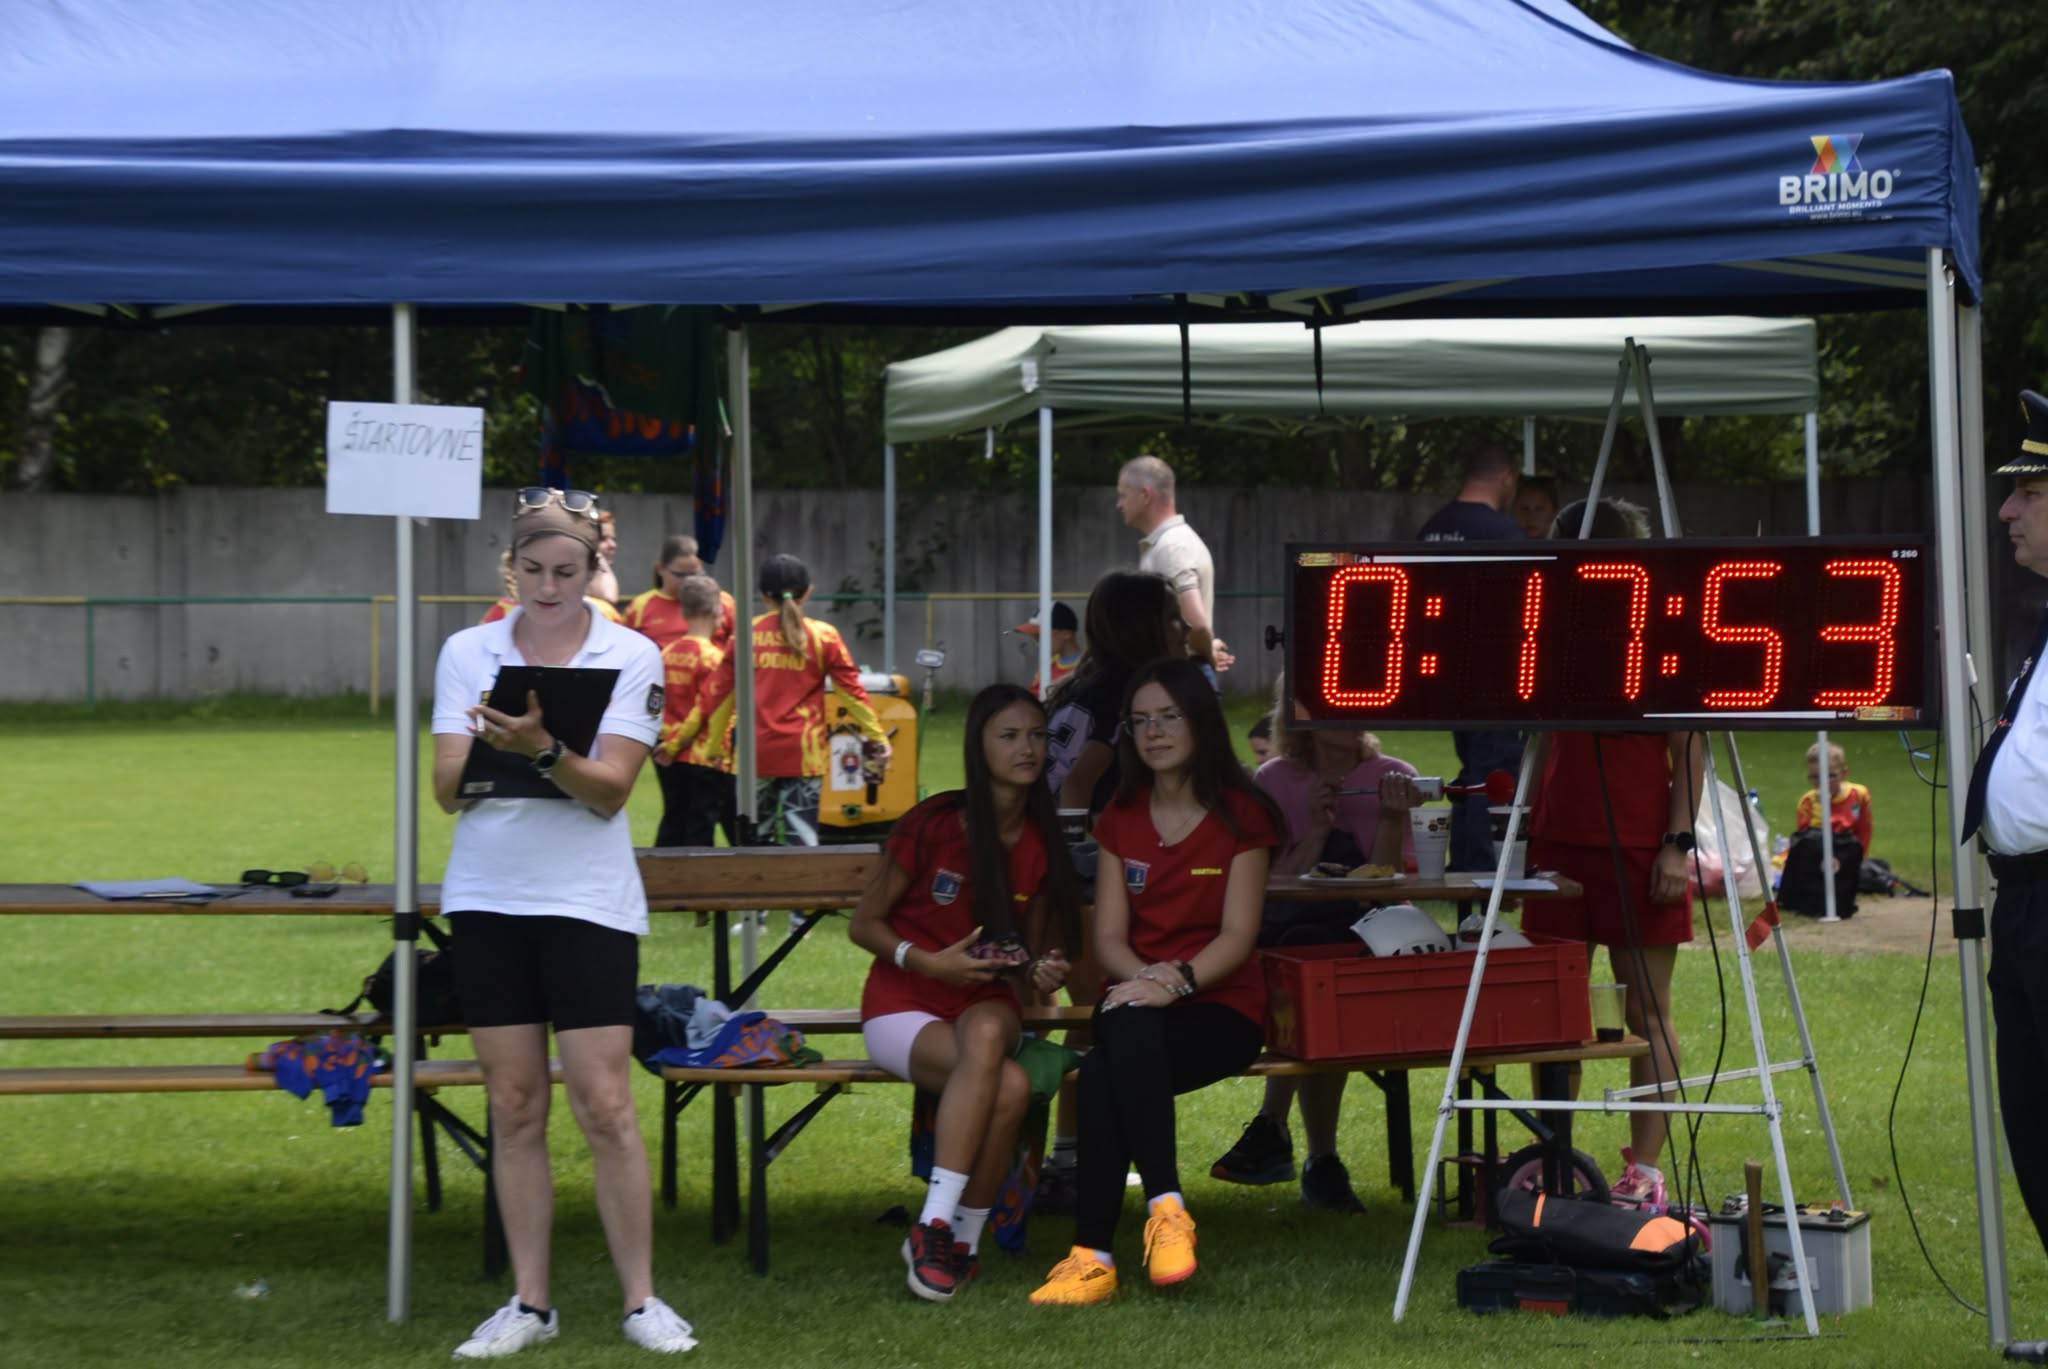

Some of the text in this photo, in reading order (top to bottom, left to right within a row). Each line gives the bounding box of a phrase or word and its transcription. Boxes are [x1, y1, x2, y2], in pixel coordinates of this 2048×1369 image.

[1779, 170, 1892, 205] BRIMO
[1788, 200, 1883, 215] BRILLIANT MOMENTS
[1322, 560, 1901, 707] 0:17:53
